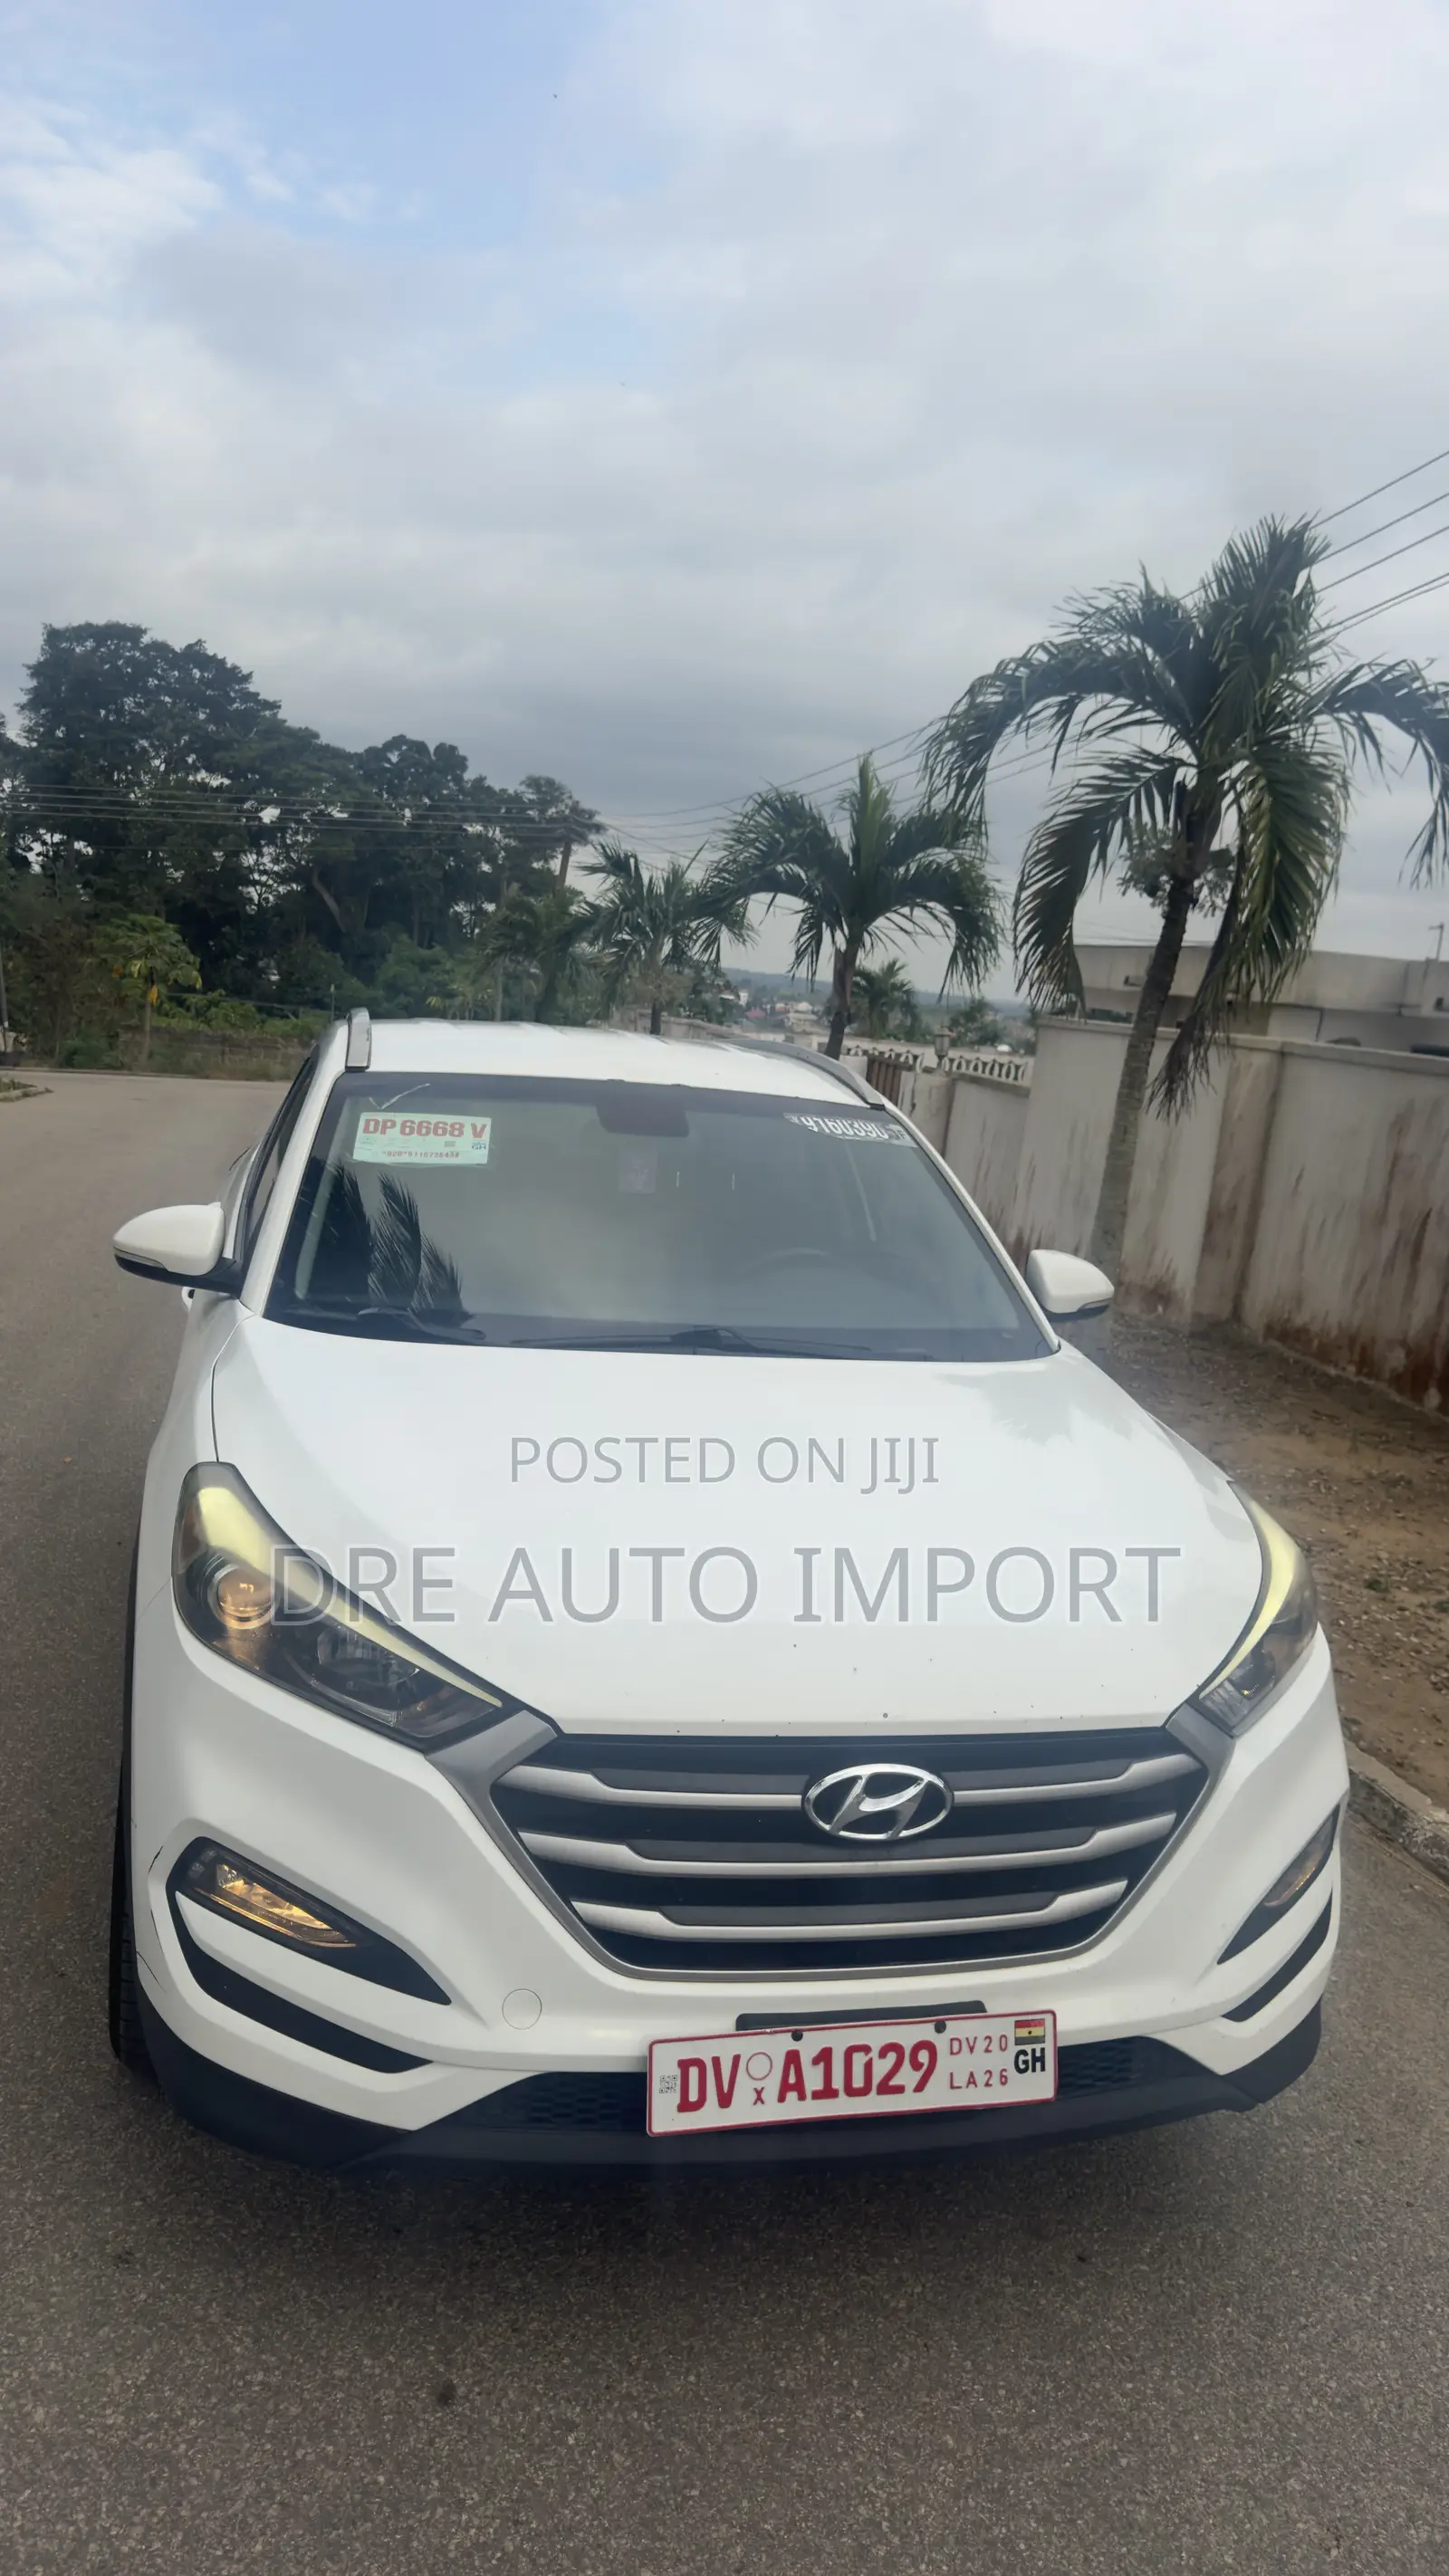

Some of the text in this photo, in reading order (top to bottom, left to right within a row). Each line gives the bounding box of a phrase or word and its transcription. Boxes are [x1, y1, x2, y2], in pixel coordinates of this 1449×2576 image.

[363, 1118, 487, 1139] DP 6668 V
[1013, 2047, 1046, 2074] GH
[677, 2054, 741, 2113] DV
[777, 2039, 938, 2103] A1029
